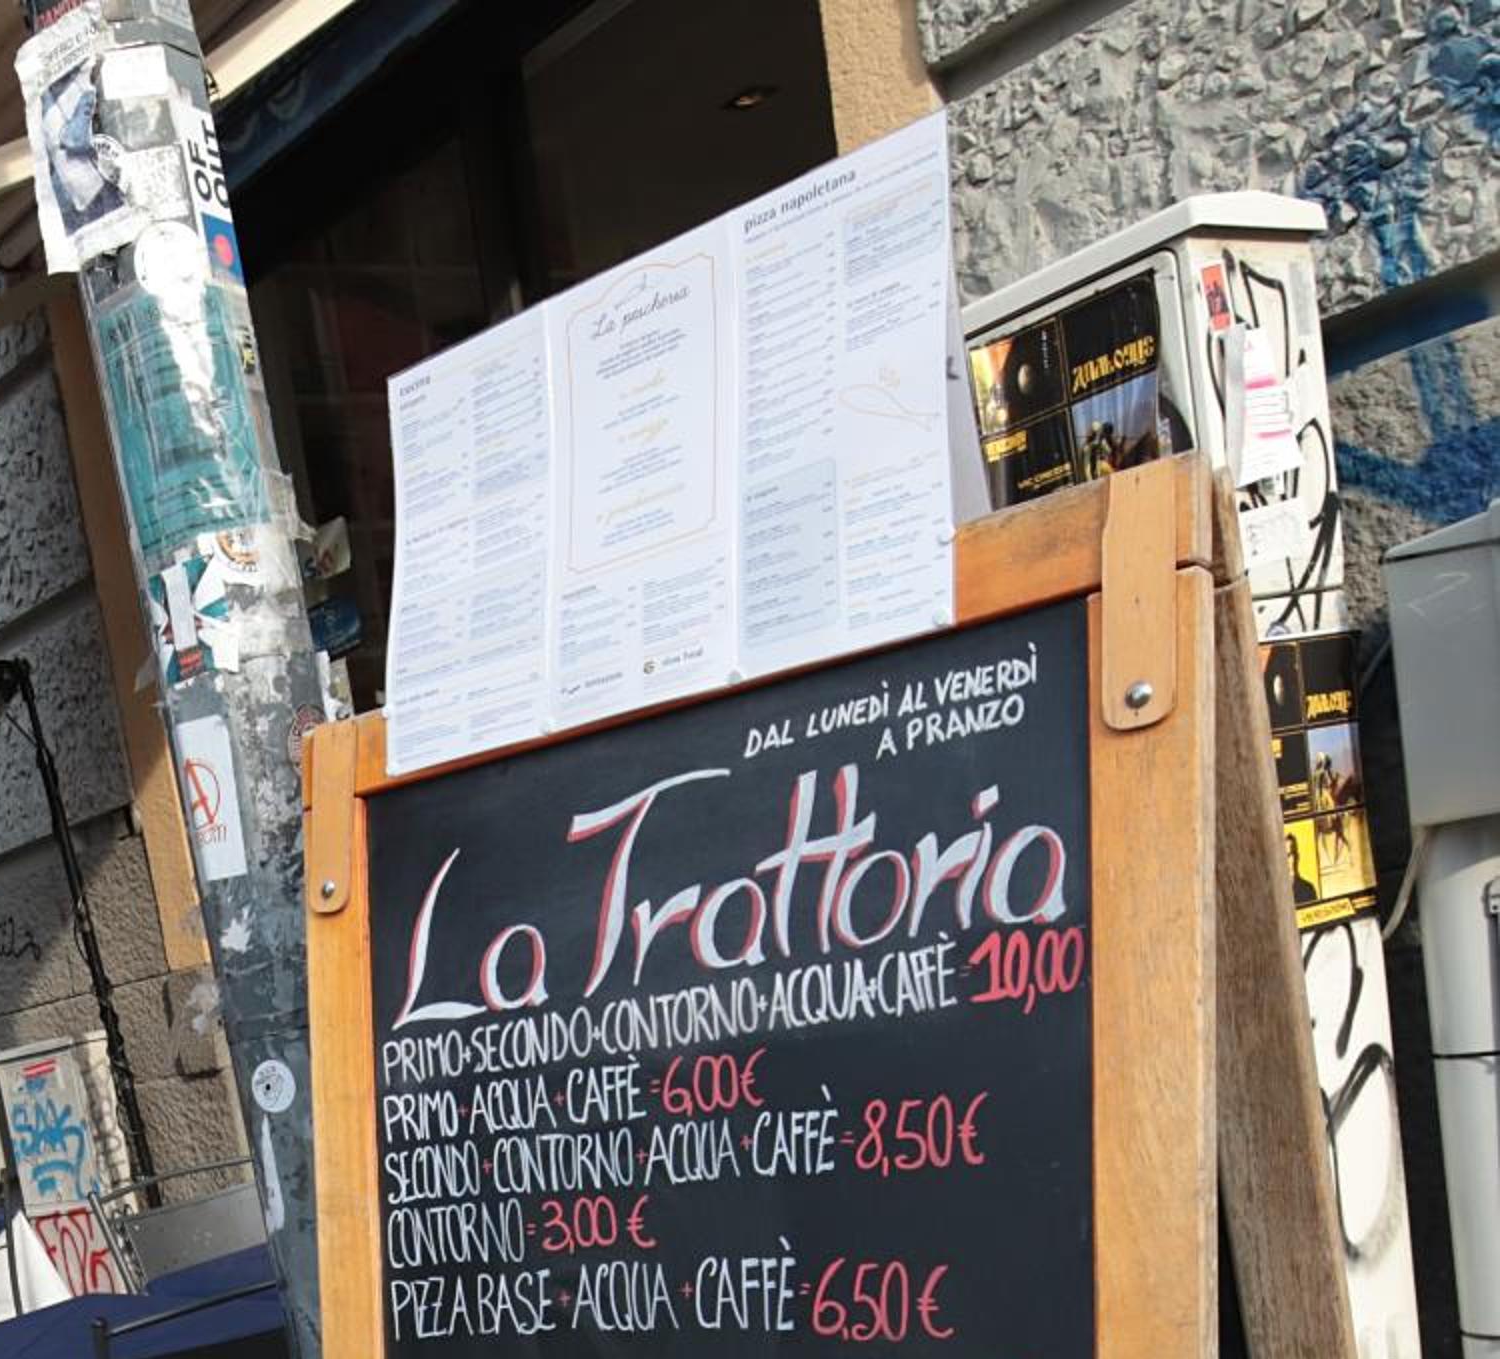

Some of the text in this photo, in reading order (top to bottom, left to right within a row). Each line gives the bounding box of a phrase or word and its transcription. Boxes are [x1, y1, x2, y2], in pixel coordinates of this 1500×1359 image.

[743, 169, 857, 234] pizza napoletana
[743, 641, 1038, 759] DAL LUNEDÌ AL VENERDÌ
[875, 693, 1026, 761] A PRANZO
[391, 762, 1068, 1031] La Trattoria
[387, 1197, 526, 1269] CONTORNO
[390, 1275, 475, 1342] PIZZA
[477, 1267, 557, 1335] BASE
[571, 1260, 680, 1333] ACQUA
